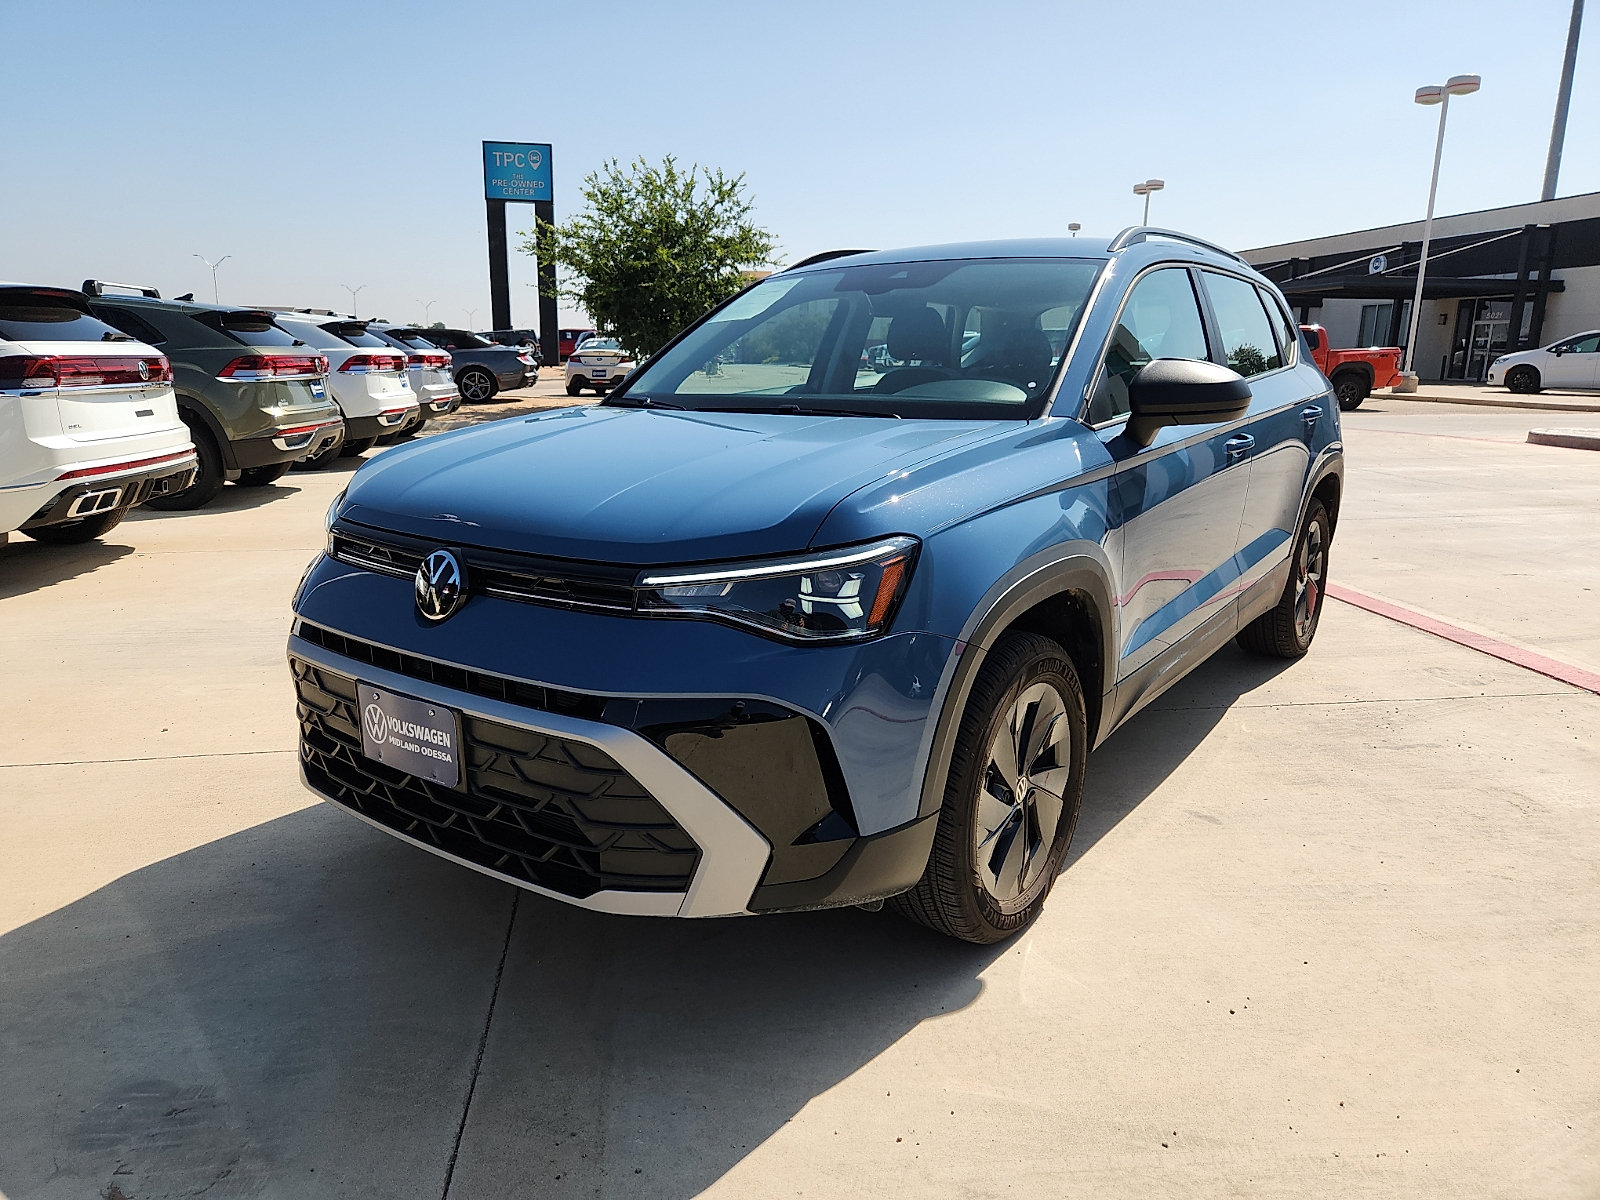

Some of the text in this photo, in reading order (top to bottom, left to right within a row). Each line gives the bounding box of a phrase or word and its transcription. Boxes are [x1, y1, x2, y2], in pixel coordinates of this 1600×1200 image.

[492, 151, 526, 168] TPC
[492, 179, 545, 189] PRE-OWNED
[502, 188, 535, 196] CENTER
[386, 715, 451, 748] VOLKSWAGEN
[388, 735, 453, 763] MIDLAND ODESSA
